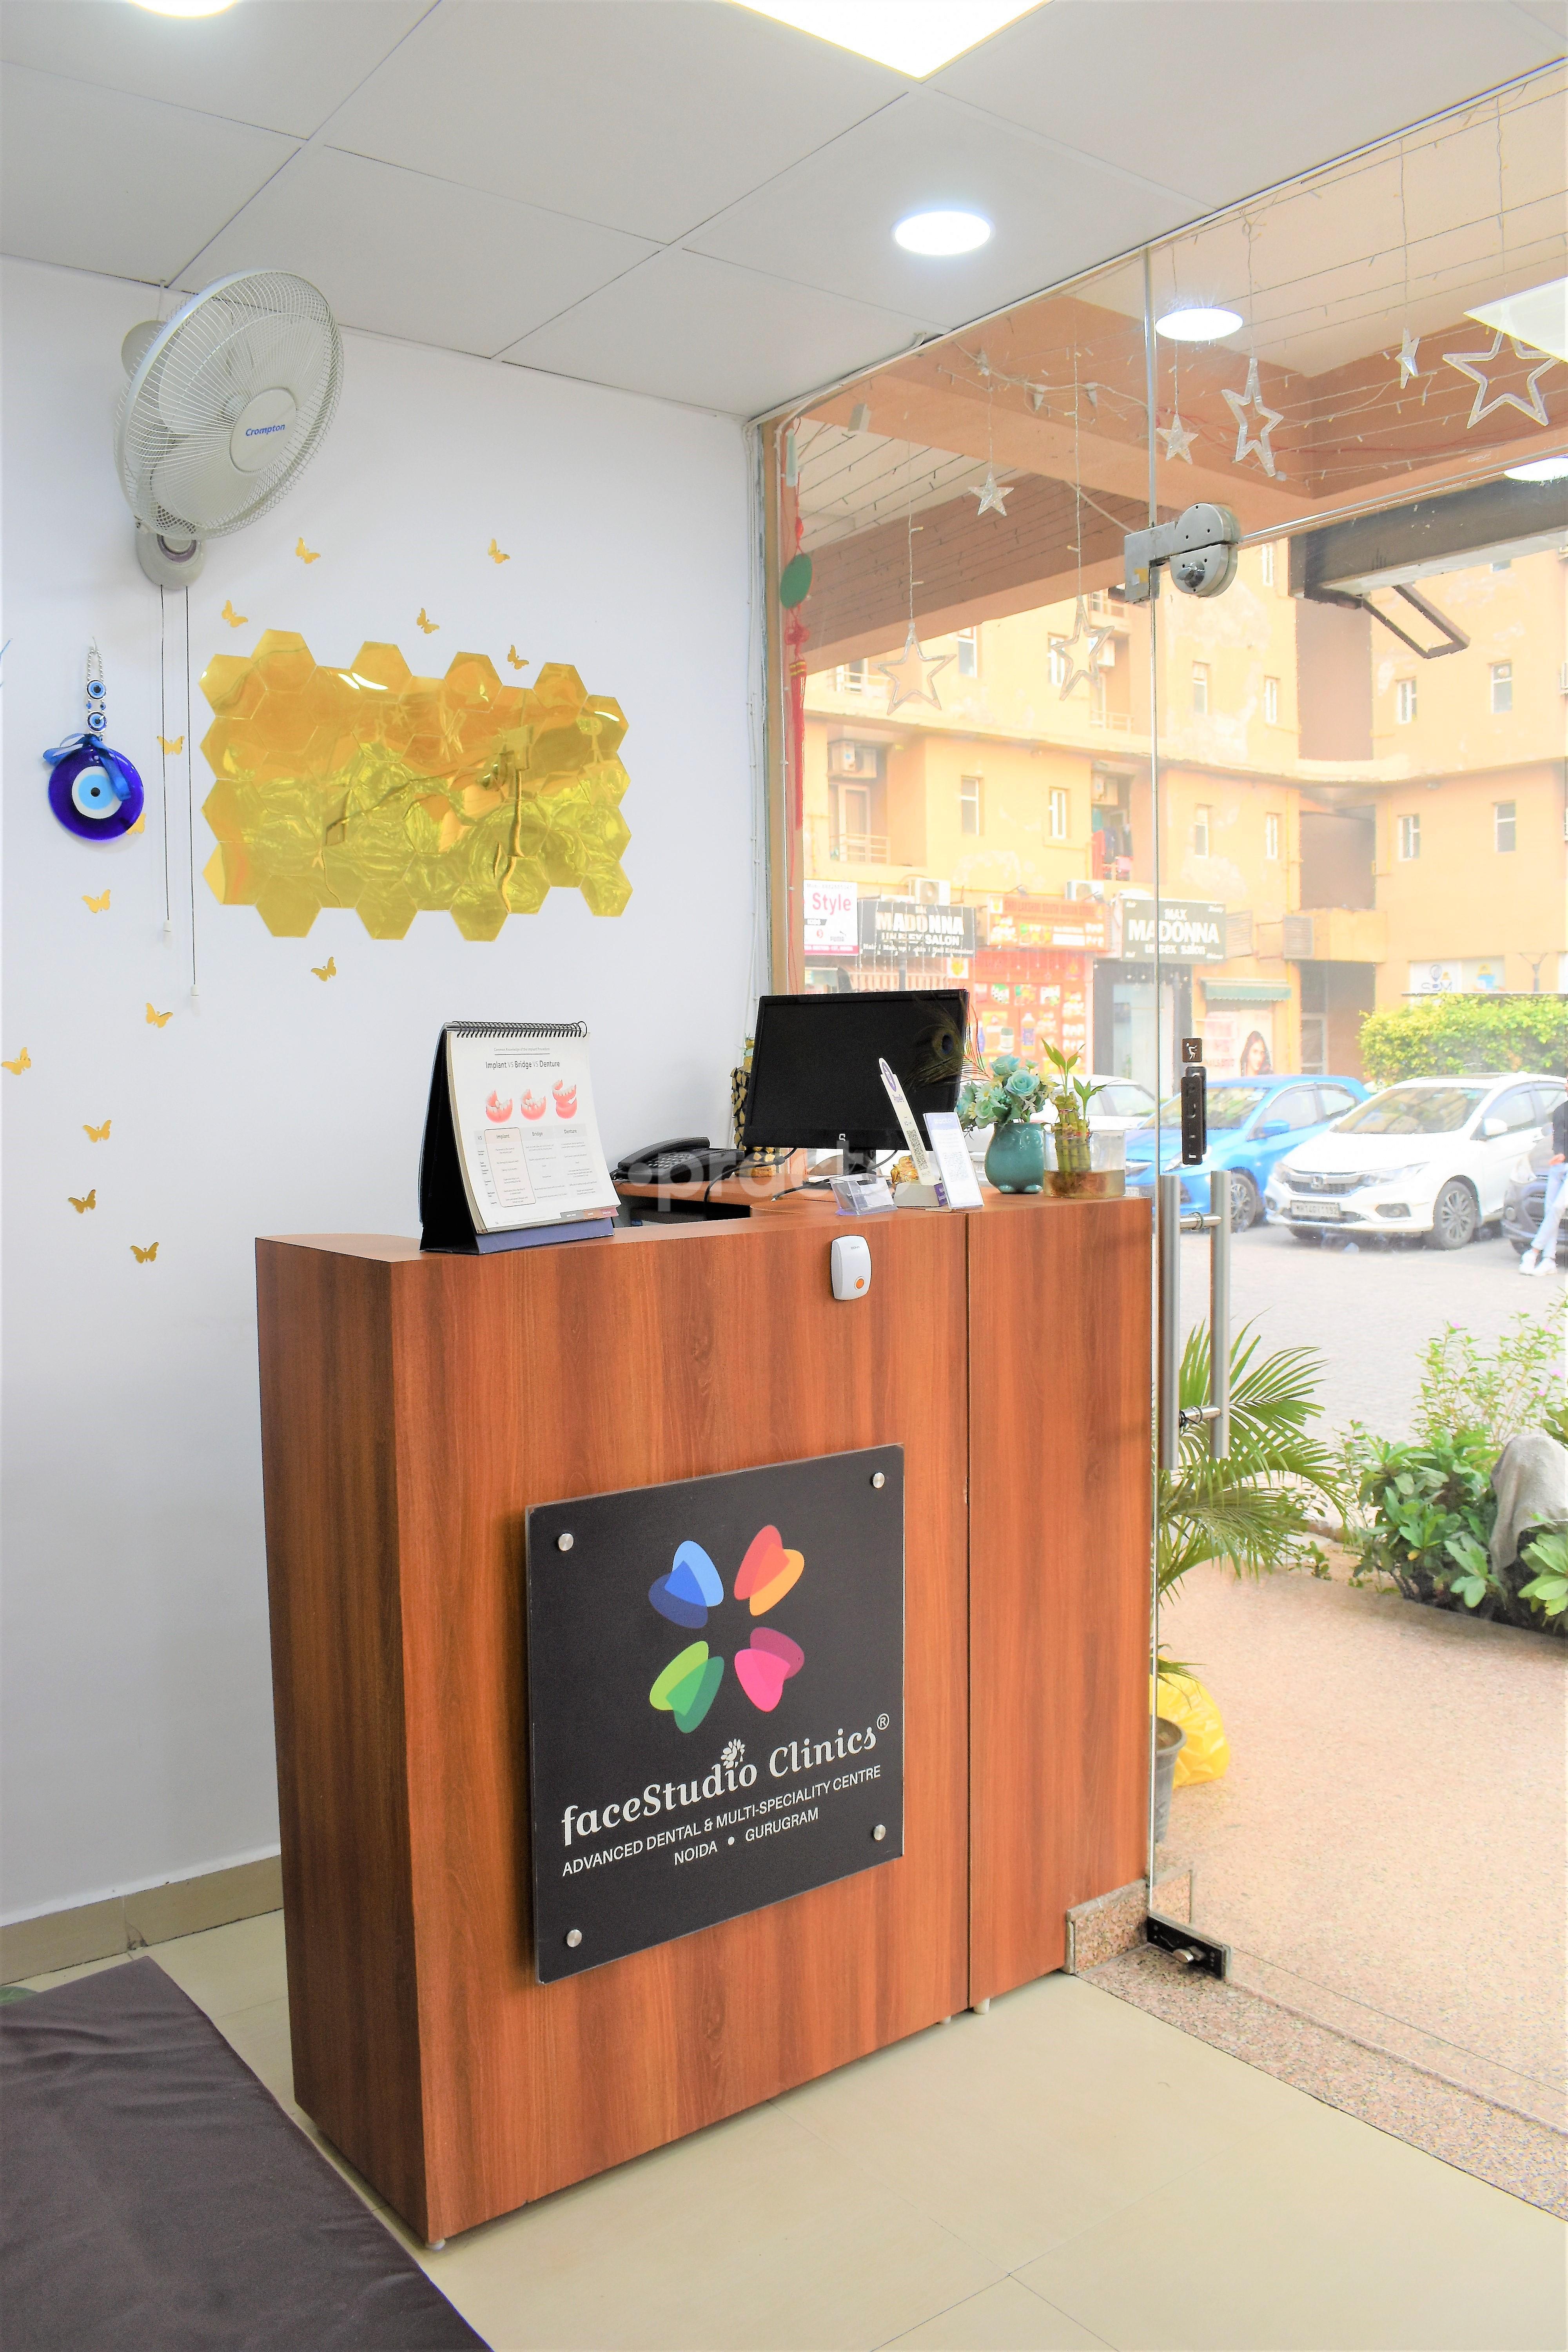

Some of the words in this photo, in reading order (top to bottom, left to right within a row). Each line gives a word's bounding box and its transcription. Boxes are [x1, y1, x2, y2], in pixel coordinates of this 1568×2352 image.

[245, 424, 285, 436] Crompton
[813, 892, 851, 915] Style
[1164, 908, 1187, 921] MAX
[876, 912, 965, 935] MADONNA
[1129, 919, 1220, 944] MADONNA
[925, 934, 960, 946] SALON
[486, 1061, 507, 1070] Implant
[515, 1060, 532, 1069] Bridge
[561, 1763, 758, 1846] faceStudio
[562, 1840, 643, 1877] ADVANCED
[646, 1823, 701, 1851] DENTAL
[704, 1818, 713, 1832] &
[716, 1781, 831, 1828] MULTI-SPECIALITY
[833, 1765, 881, 1791] CENTRE
[674, 1840, 718, 1865] NOIDA
[745, 1807, 819, 1842] GURUGRAM
